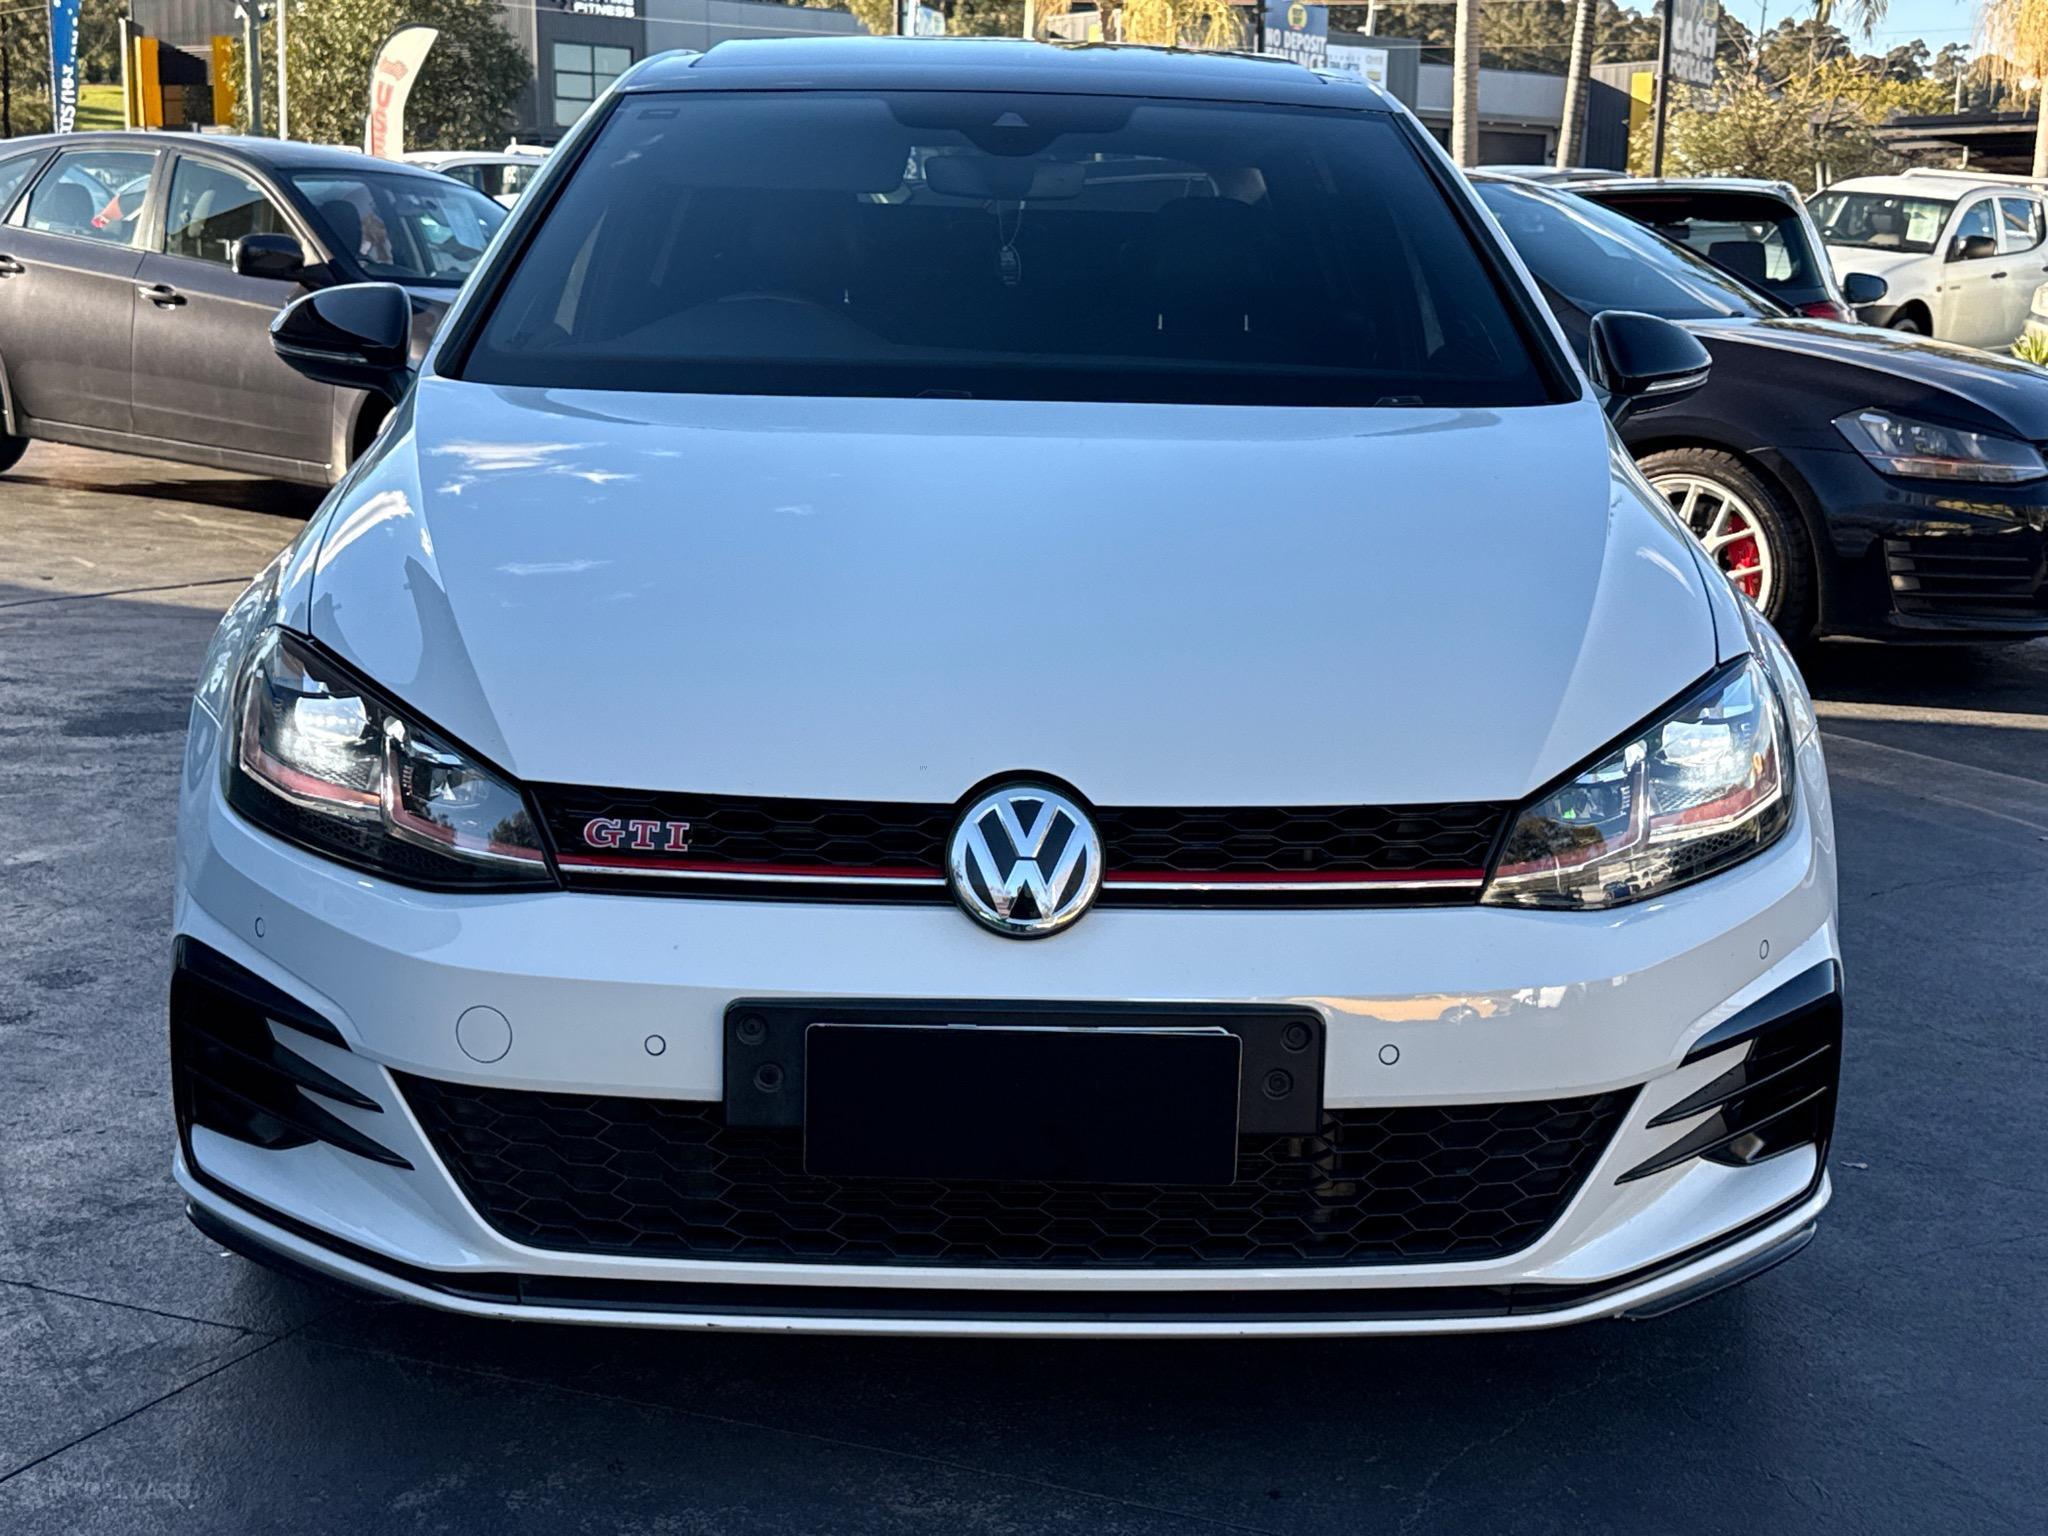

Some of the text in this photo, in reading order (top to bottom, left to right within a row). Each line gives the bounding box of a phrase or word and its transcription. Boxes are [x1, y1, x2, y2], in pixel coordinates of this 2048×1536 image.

[1264, 27, 1327, 55] NO DEPOSIT
[1672, 17, 1716, 60] CASH
[583, 817, 690, 852] GTI
